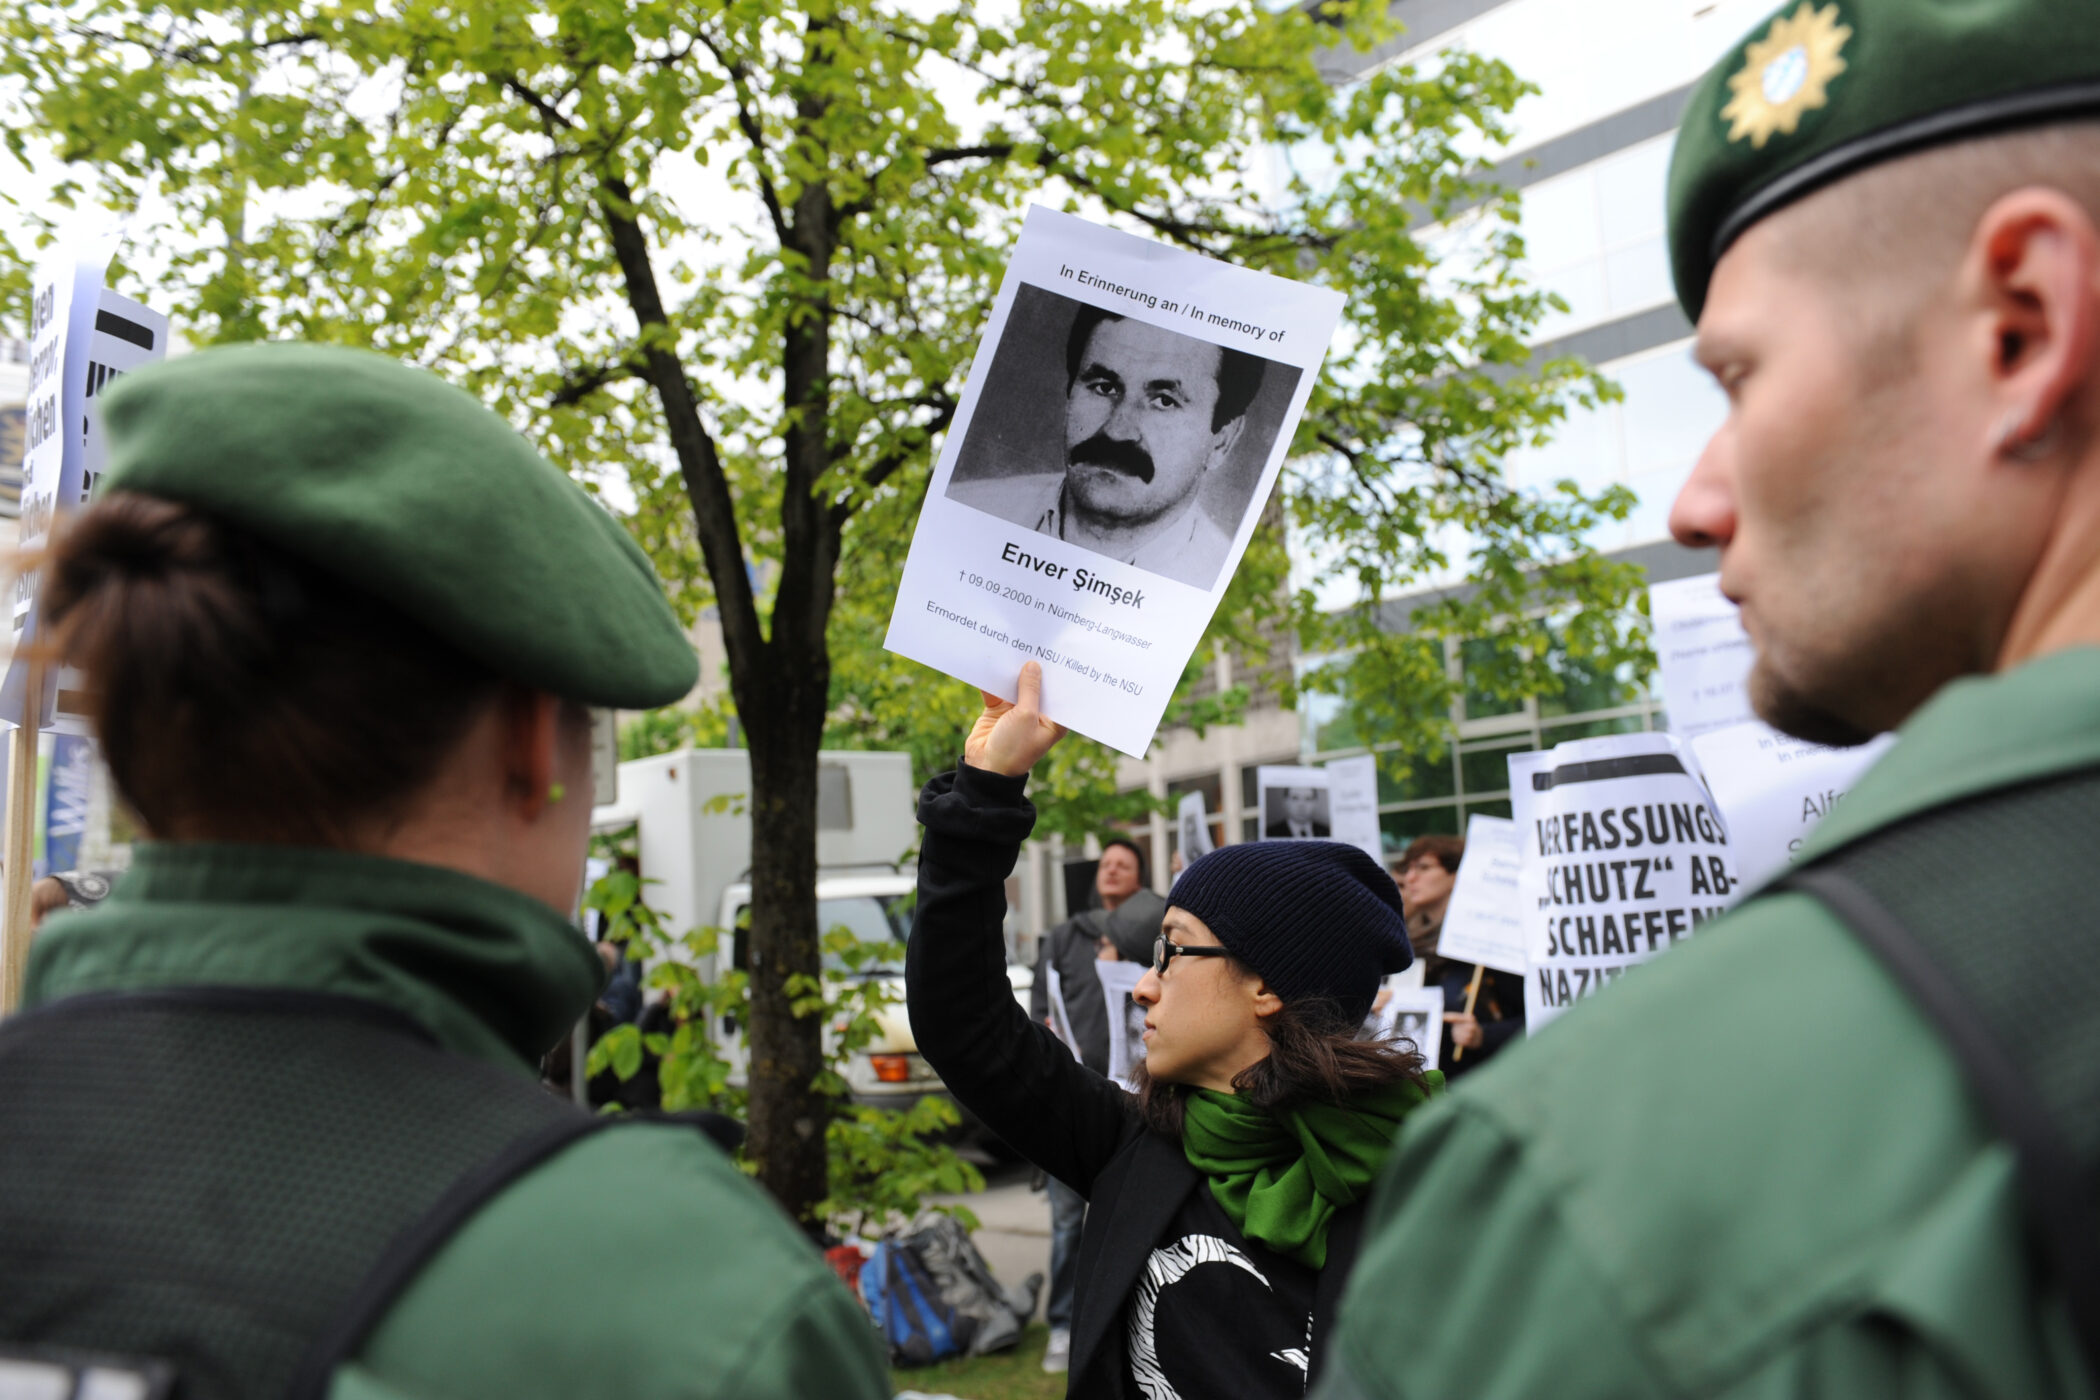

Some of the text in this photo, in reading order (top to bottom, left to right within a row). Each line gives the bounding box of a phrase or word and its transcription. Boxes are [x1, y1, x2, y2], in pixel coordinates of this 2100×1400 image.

[1060, 264, 1286, 342] In Erinnerung an / In memory of
[968, 573, 1033, 606] 09.09.2000
[1034, 598, 1046, 611] in
[1048, 603, 1153, 650] Nürnberg-Langwasser
[1002, 542, 1145, 609] Enver Şimşek
[926, 600, 978, 630] Ermordet
[979, 624, 1009, 644] durch
[1011, 638, 1033, 653] den
[1036, 646, 1060, 664] NSU
[1065, 657, 1090, 676] Killed
[1090, 667, 1102, 682] by
[1102, 672, 1118, 687] the
[1119, 679, 1144, 696] NSU
[1691, 855, 1738, 895] AB-
